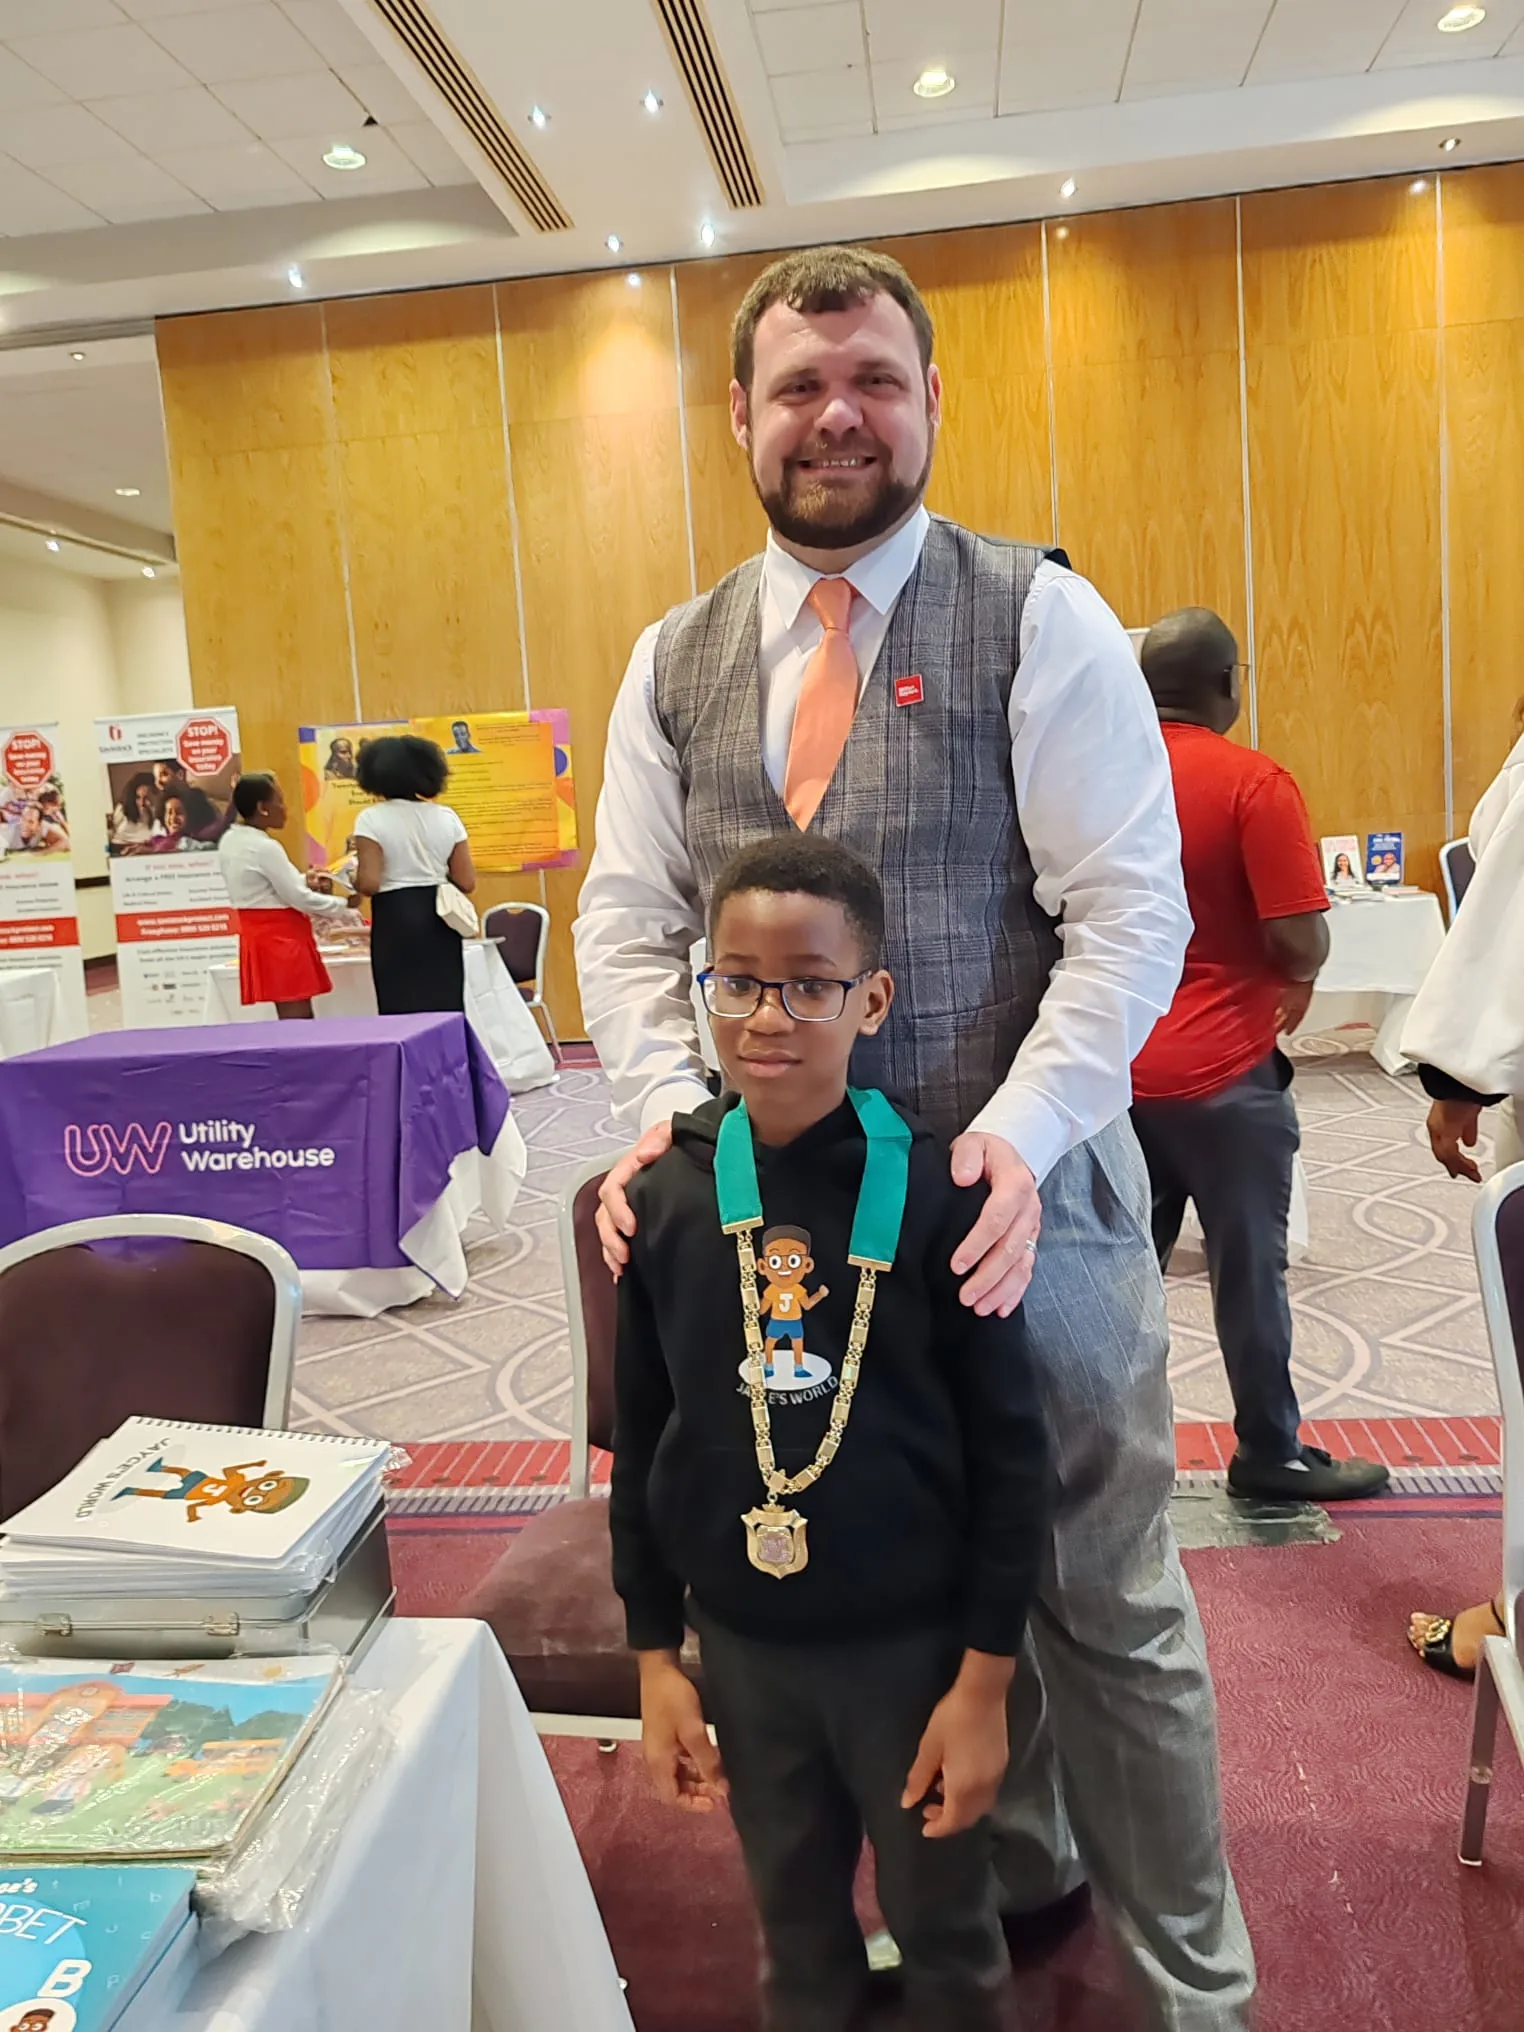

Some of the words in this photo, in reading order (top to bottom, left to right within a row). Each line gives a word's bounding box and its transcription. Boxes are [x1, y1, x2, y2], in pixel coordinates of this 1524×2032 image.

[64, 1121, 172, 1177] UW
[178, 1119, 255, 1149] Utility
[180, 1146, 335, 1172] Warehouse
[778, 1293, 794, 1313] J
[735, 1382, 788, 1405] JAE'S
[789, 1376, 839, 1405] WORLD
[76, 1481, 115, 1519] WORLD
[37, 1959, 93, 1998] B
